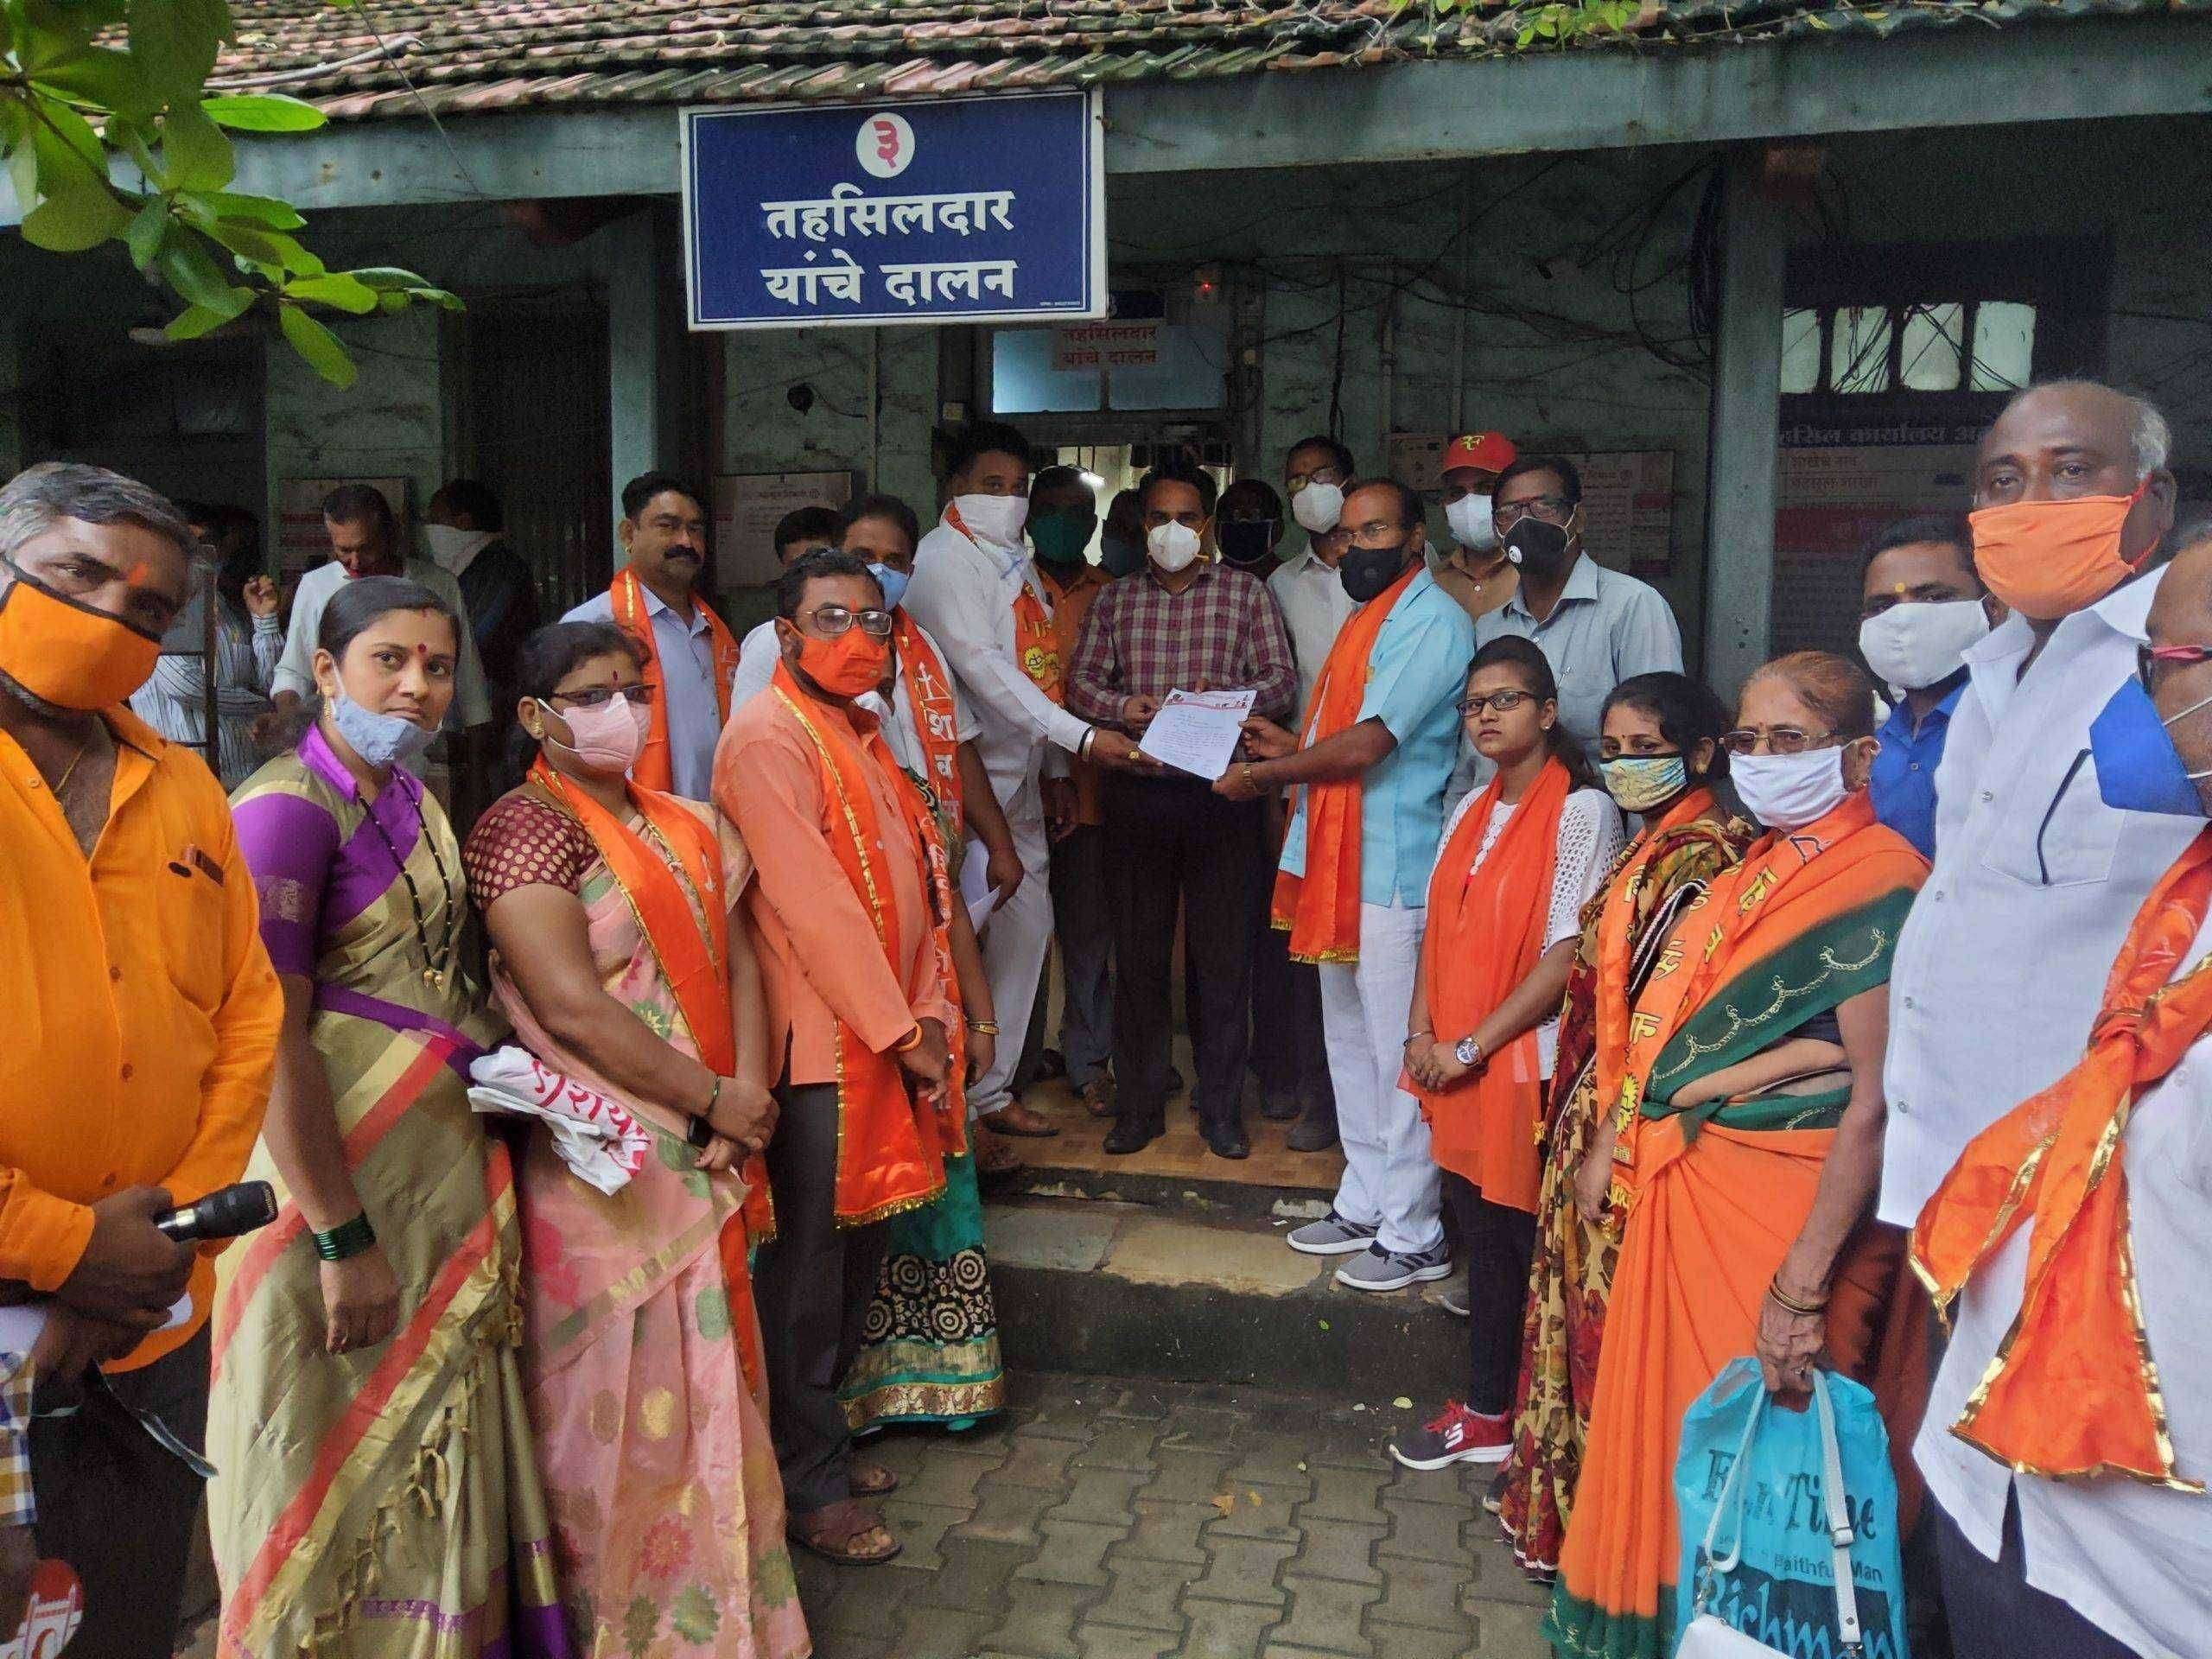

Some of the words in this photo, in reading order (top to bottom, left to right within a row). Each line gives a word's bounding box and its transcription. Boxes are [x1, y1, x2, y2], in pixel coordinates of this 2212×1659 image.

[874, 120, 899, 168] ३
[760, 182, 1015, 241] तहसिलदार
[760, 249, 865, 305] यांचे
[880, 260, 1019, 306] दालन
[1774, 1554, 1836, 1578] Faithfu
